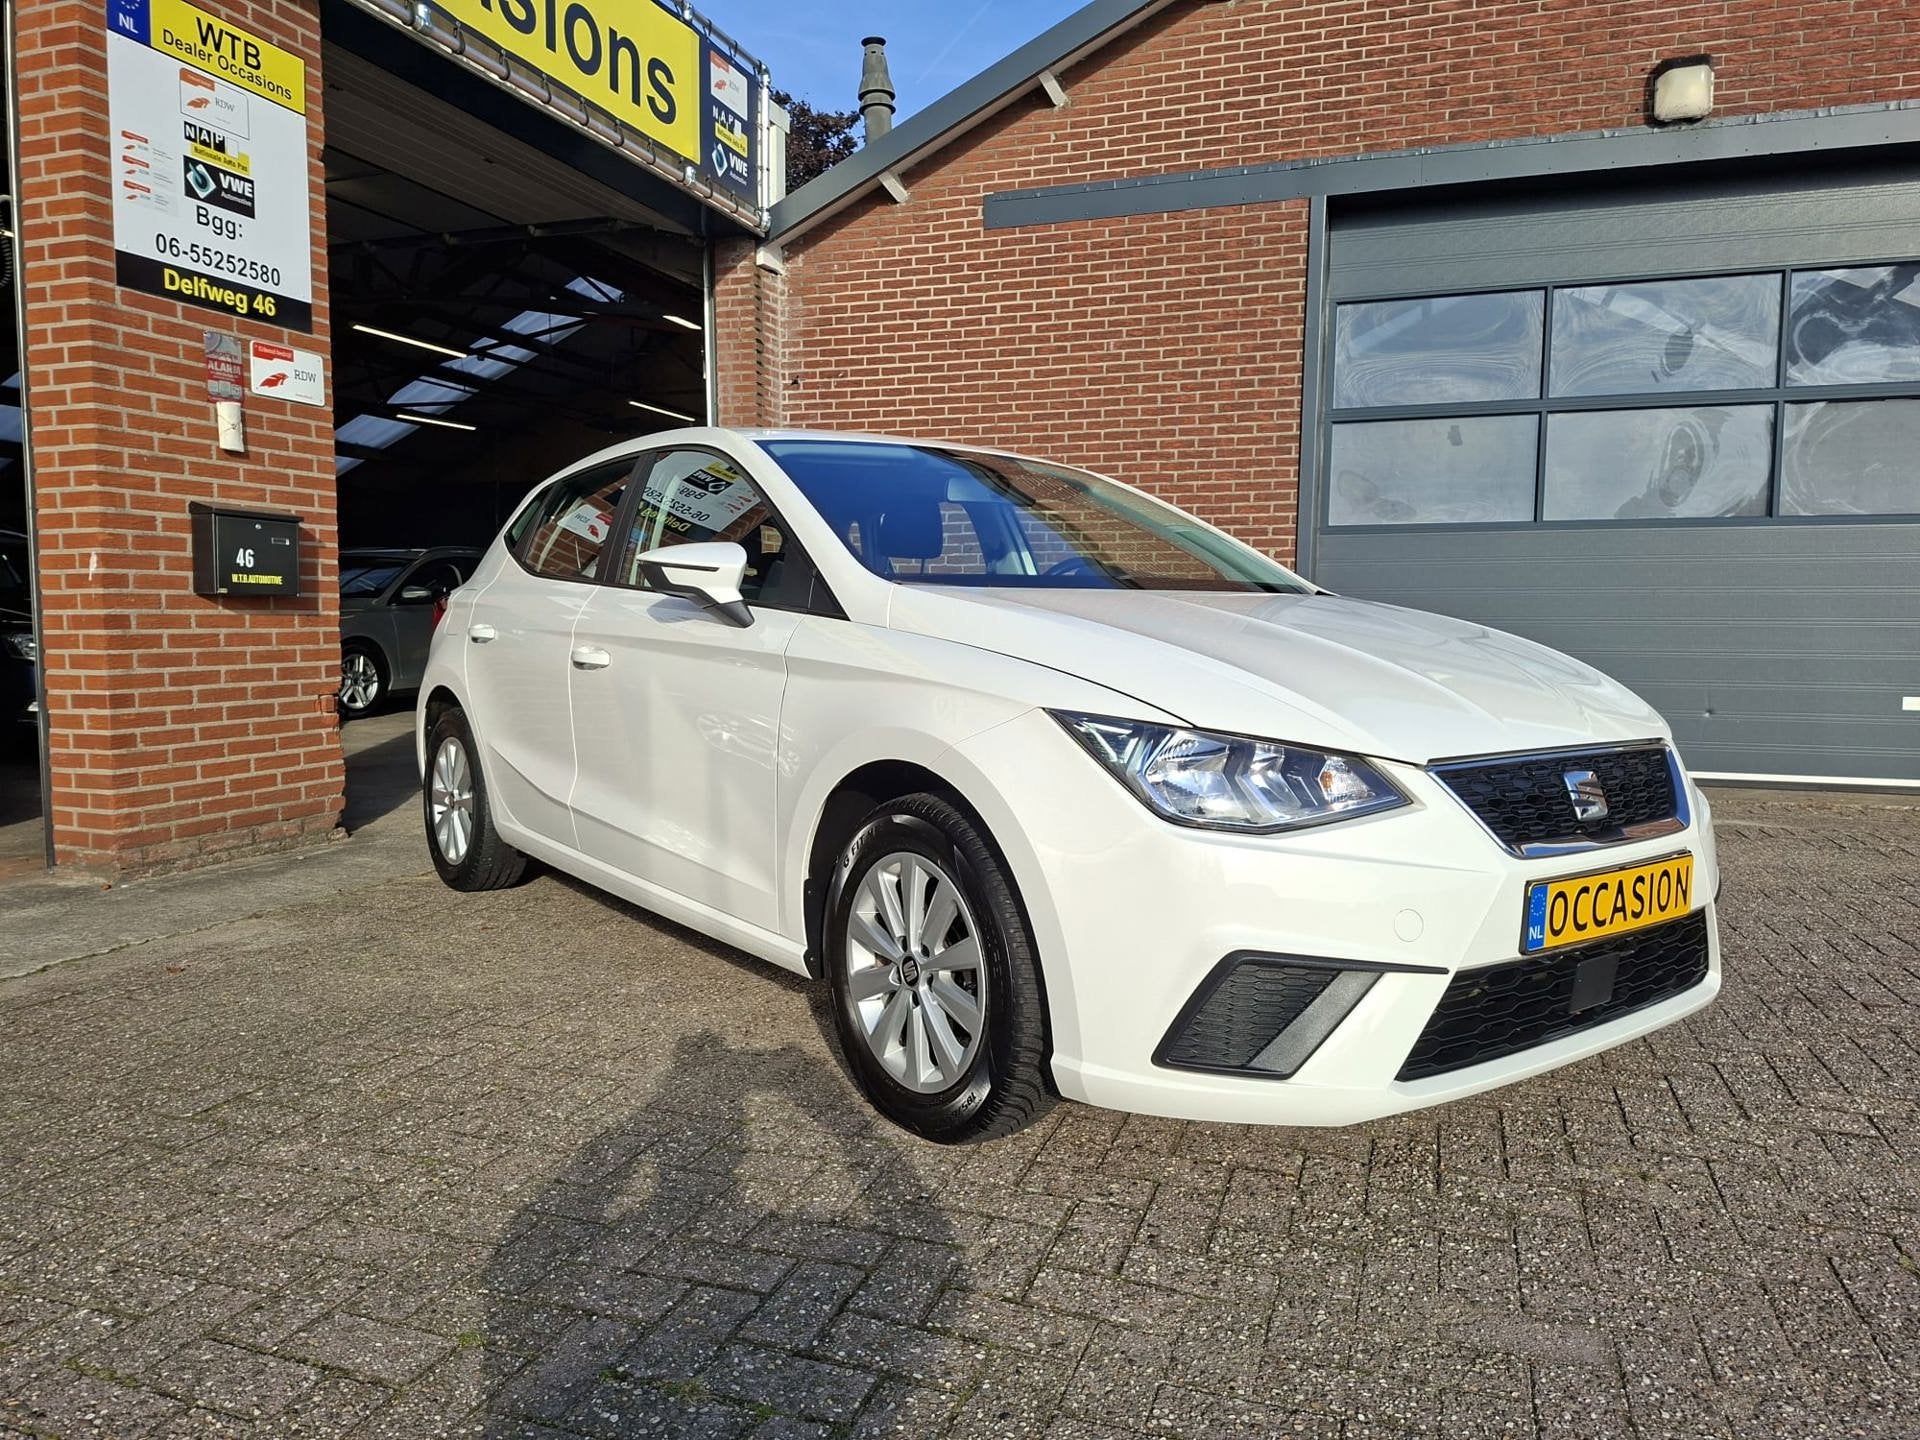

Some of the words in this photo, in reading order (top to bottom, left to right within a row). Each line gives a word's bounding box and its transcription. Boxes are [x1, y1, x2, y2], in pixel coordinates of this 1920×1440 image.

[118, 12, 139, 33] NL
[196, 16, 262, 70] WTB
[162, 28, 213, 64] Dealer
[217, 54, 292, 101] Occasions
[480, 0, 677, 124] sions
[729, 151, 748, 178] VWE
[219, 171, 253, 198] VWE
[196, 204, 243, 240] Bgg:
[155, 232, 281, 287] 06-55252580
[163, 267, 249, 314] Delfweg
[253, 293, 277, 317] 46
[294, 369, 317, 383] RDW
[236, 547, 255, 568] 46
[1548, 865, 1690, 937] OCCASION
[1528, 926, 1544, 941] NL
